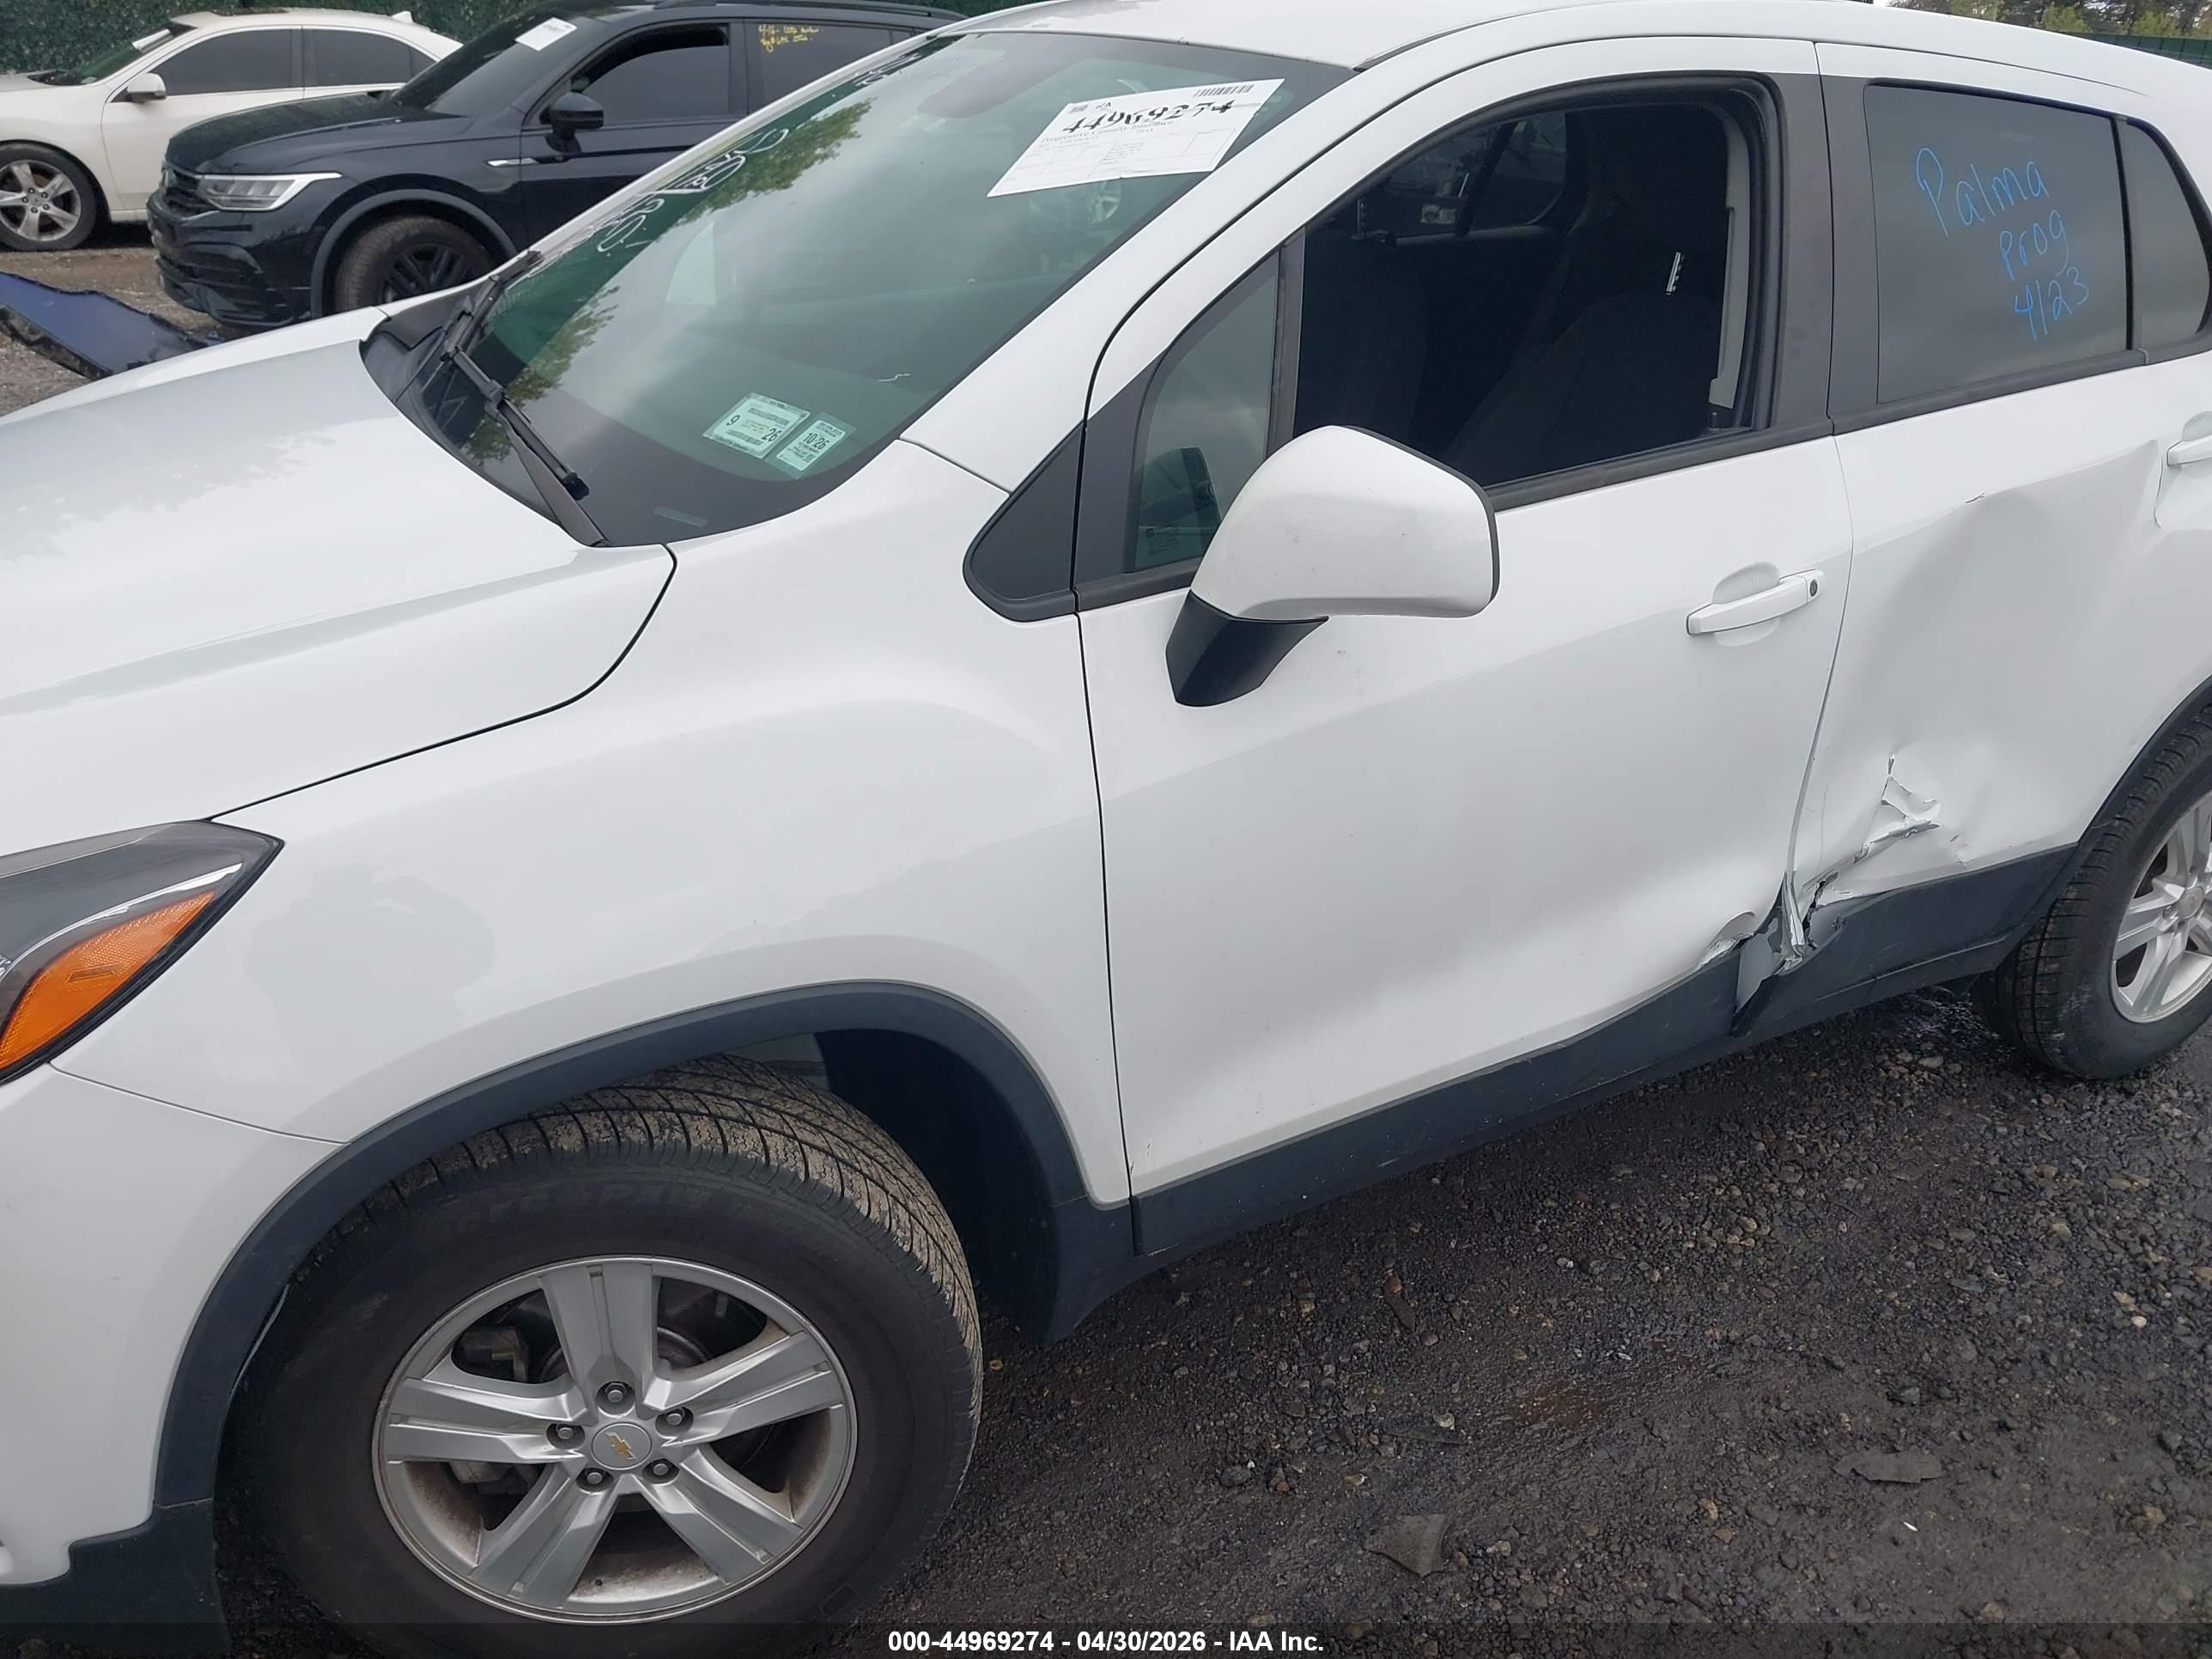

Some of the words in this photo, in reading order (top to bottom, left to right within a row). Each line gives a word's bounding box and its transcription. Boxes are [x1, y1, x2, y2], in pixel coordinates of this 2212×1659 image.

[1063, 99, 1235, 133] 44969274
[1916, 148, 2049, 236] Palma
[726, 415, 741, 427] 9
[761, 428, 782, 443] 26
